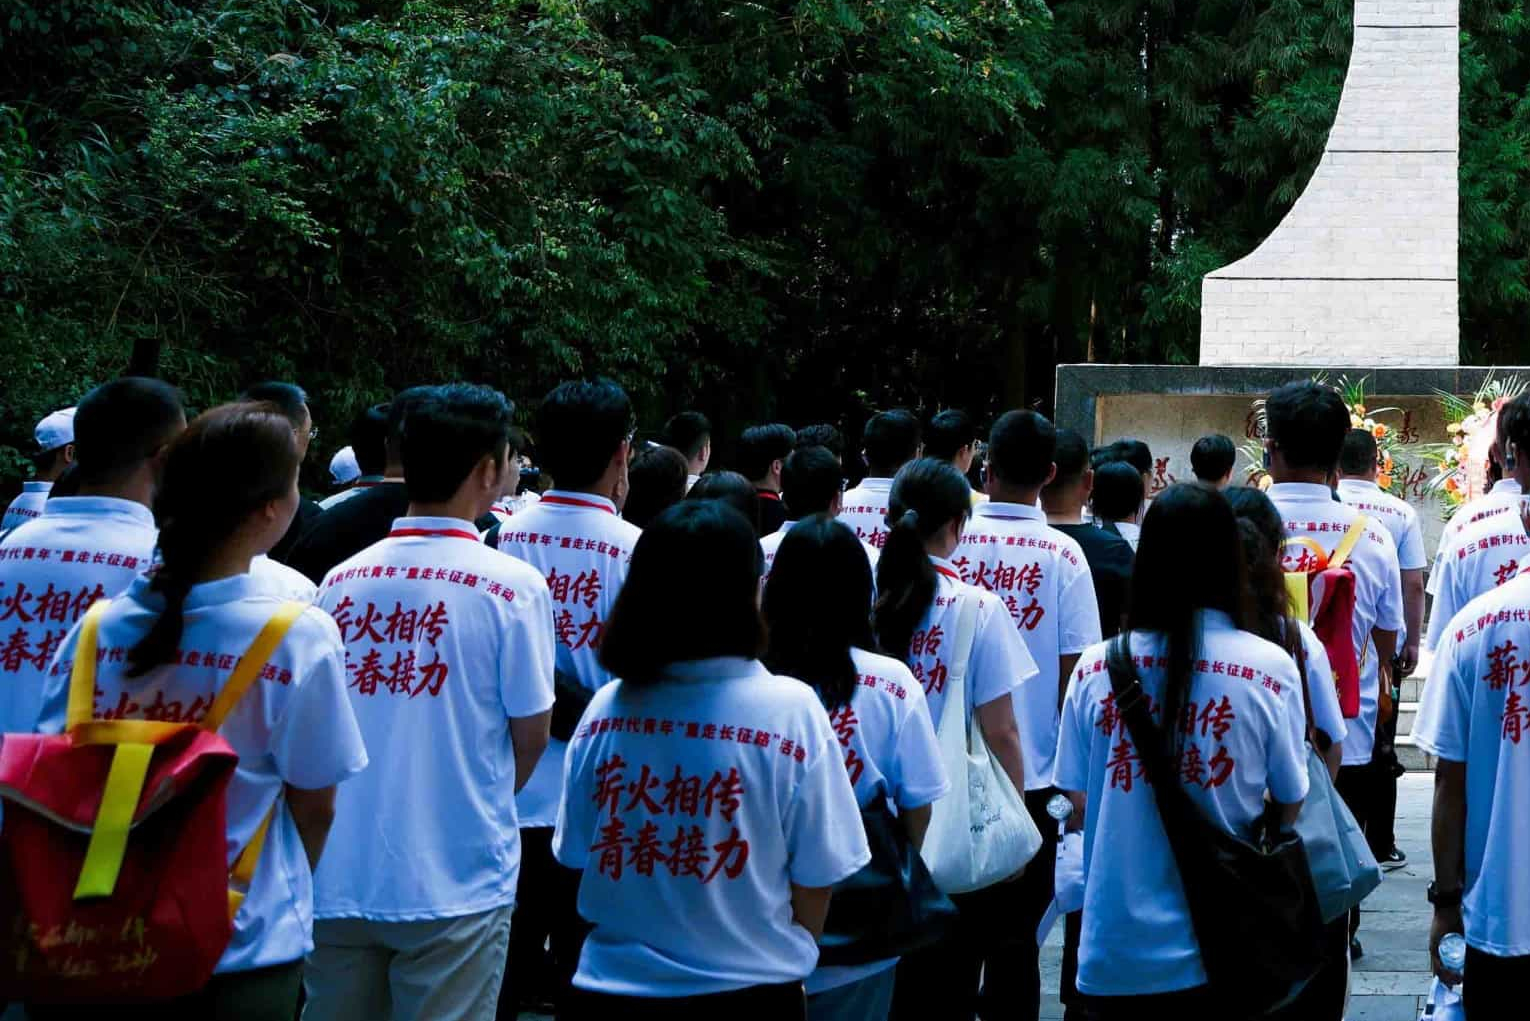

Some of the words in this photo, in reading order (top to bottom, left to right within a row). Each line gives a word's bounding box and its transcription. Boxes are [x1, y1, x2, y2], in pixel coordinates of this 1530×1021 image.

[590, 753, 745, 823] 薪火相传
[590, 819, 750, 885] 青春接力
